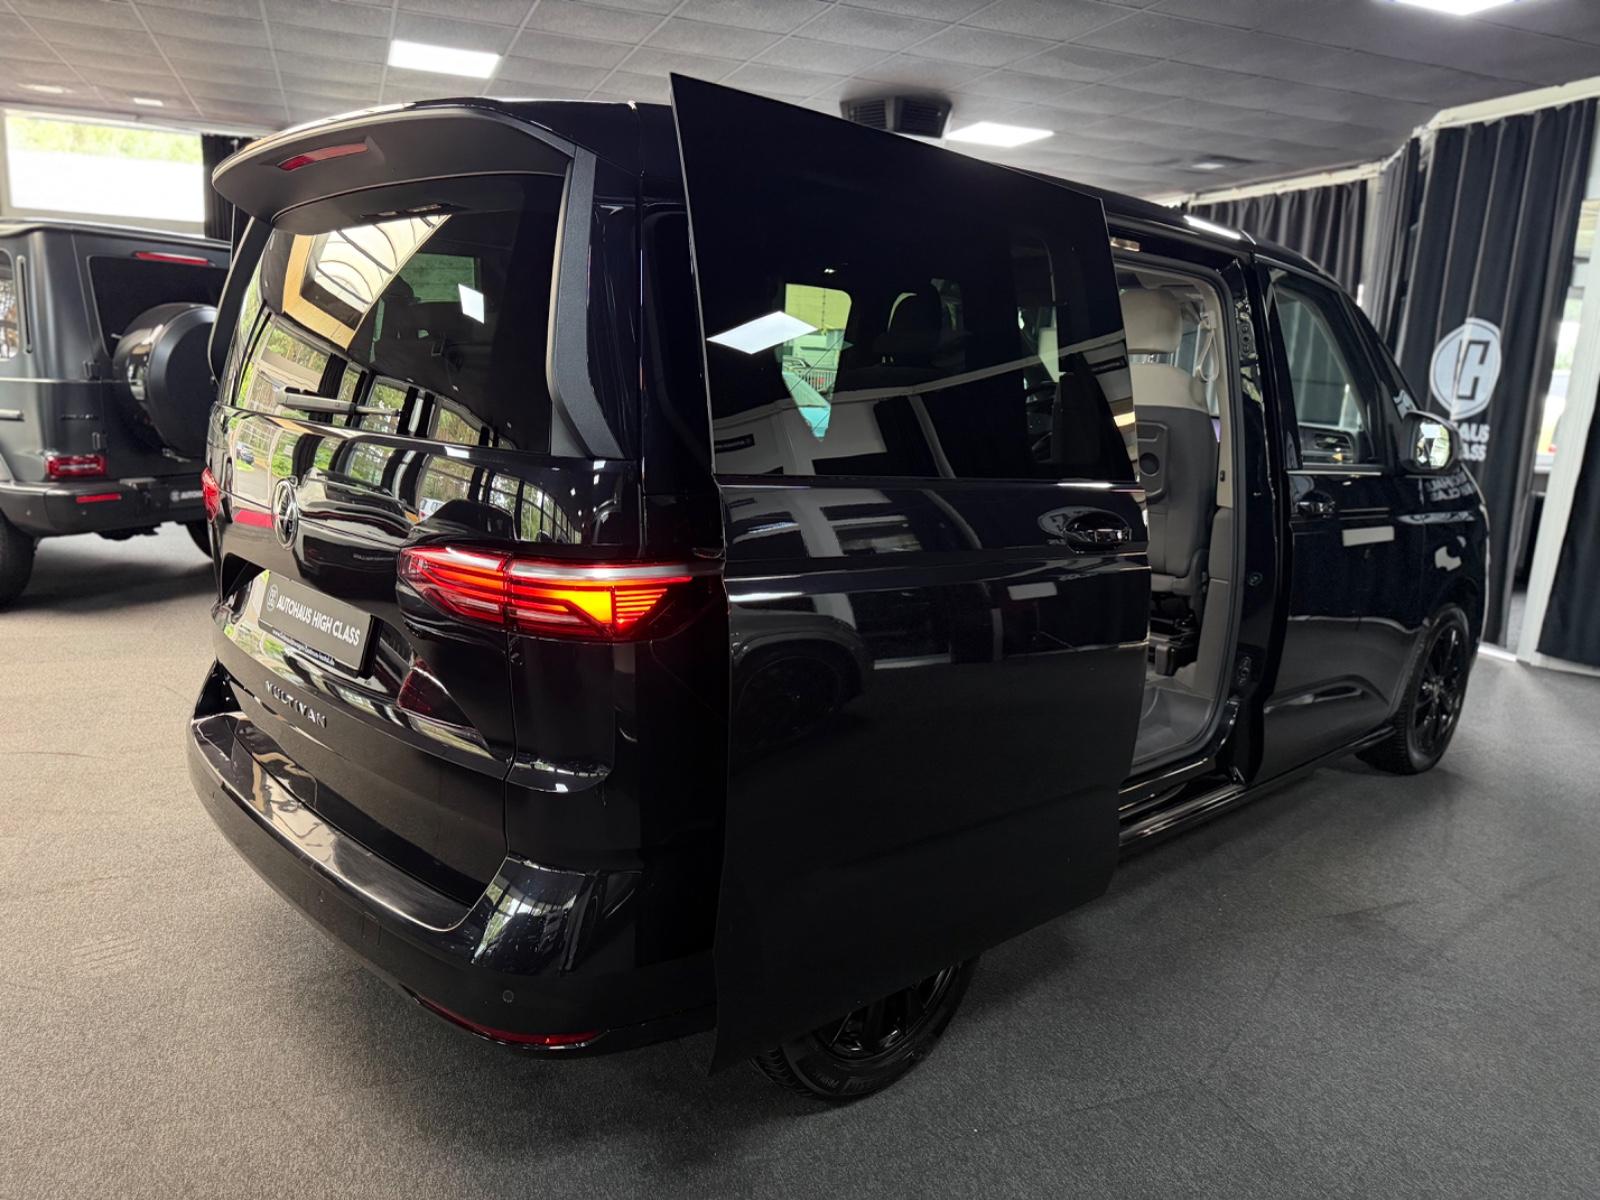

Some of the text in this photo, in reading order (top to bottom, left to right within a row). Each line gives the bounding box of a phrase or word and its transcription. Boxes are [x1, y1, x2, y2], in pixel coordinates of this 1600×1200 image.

[276, 595, 312, 624] AUTOHAUS
[311, 611, 334, 634] HIGH
[333, 620, 360, 647] CLASS
